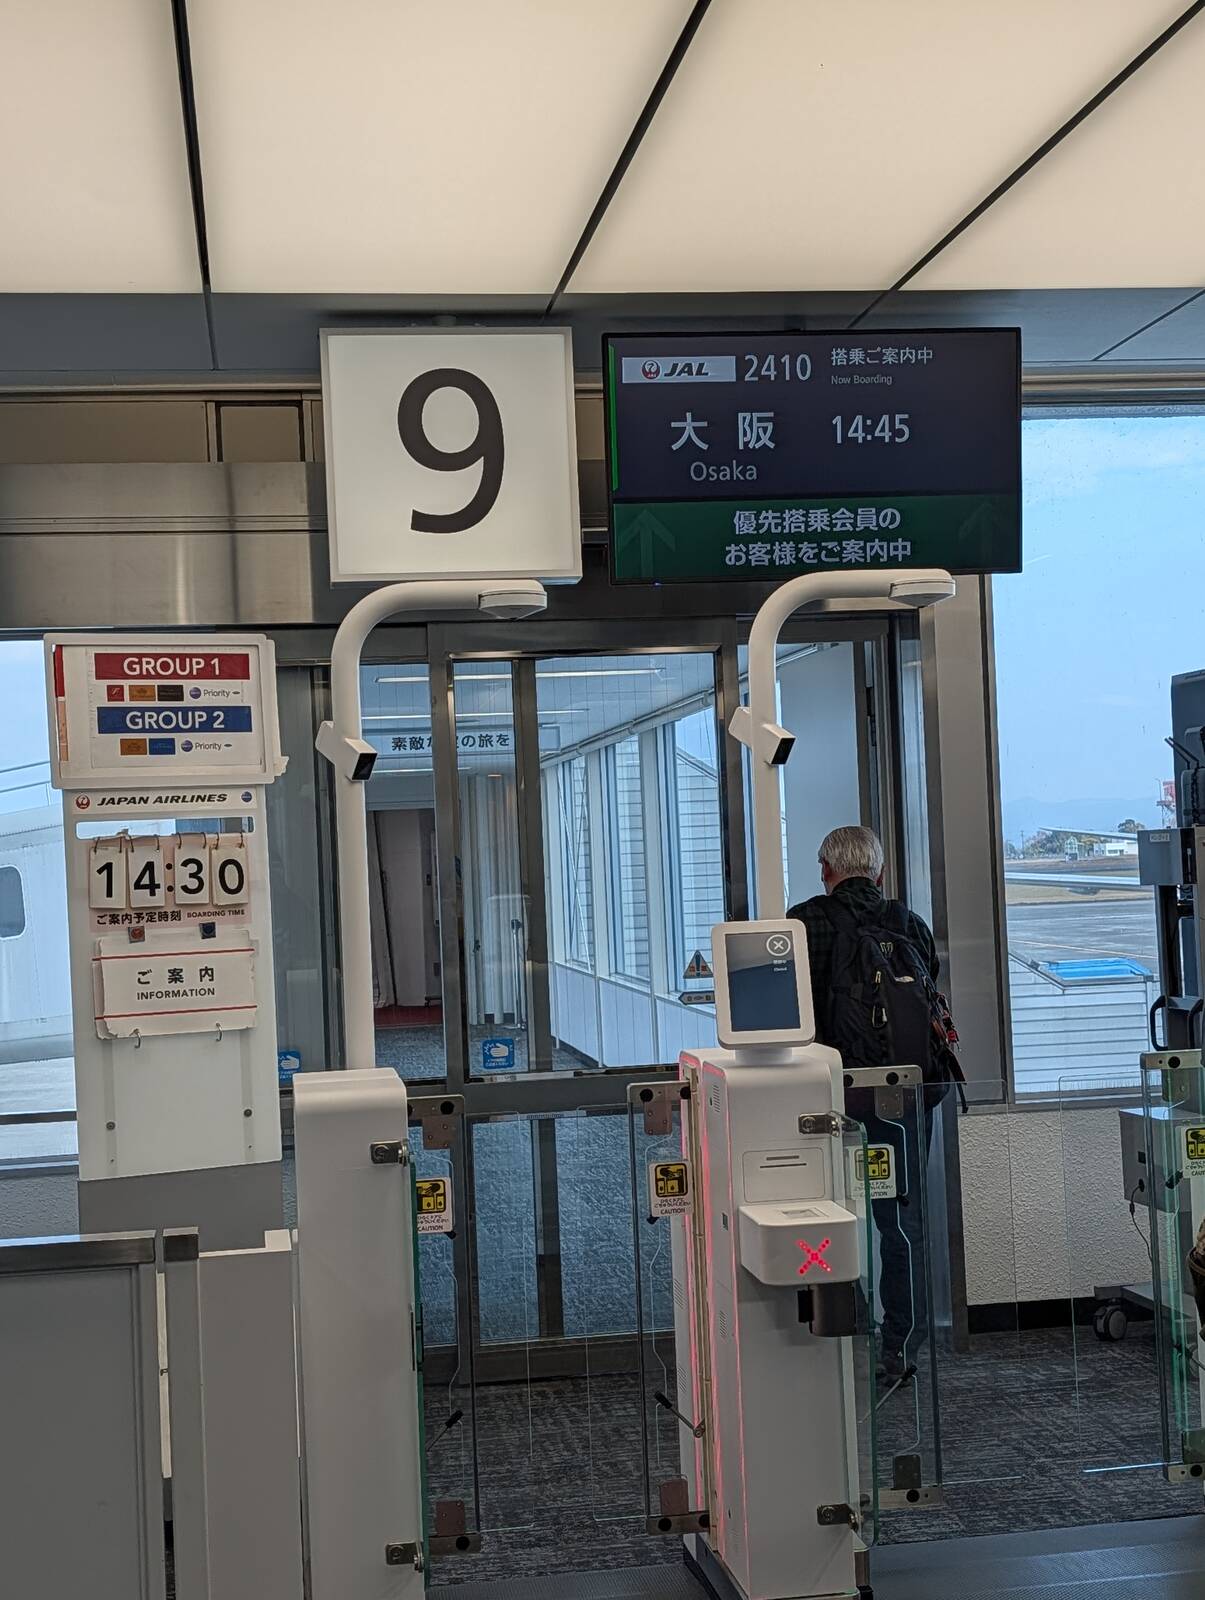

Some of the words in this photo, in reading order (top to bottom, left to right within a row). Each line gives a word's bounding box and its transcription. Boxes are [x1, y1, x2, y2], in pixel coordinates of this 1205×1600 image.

[831, 347, 933, 366] 搭乗ご案内中
[664, 362, 709, 377] JAL
[744, 355, 811, 381] 2410
[831, 376, 850, 385] Now
[854, 375, 893, 386] Boarding
[831, 413, 910, 445] 14:45
[398, 368, 505, 534] 9
[690, 460, 757, 482] Osaka
[733, 508, 901, 536] 優先搭乗会員の
[725, 539, 911, 567] お客様をご案内中
[123, 657, 205, 676] GROUP
[210, 658, 220, 675] 1
[203, 689, 231, 698] Priority
[125, 710, 207, 730] GROUP
[212, 711, 225, 729] 2
[195, 742, 222, 751] Priority
[391, 733, 510, 751] 素敵の旅を
[97, 796, 150, 806] JAPAN
[152, 793, 228, 804] AIRLINES
[96, 858, 245, 898] 14:30
[96, 910, 182, 926] ご案内予定時刻
[187, 910, 226, 918] BOARDING
[137, 967, 215, 986] ご案内
[137, 987, 216, 1000] INFORMATION
